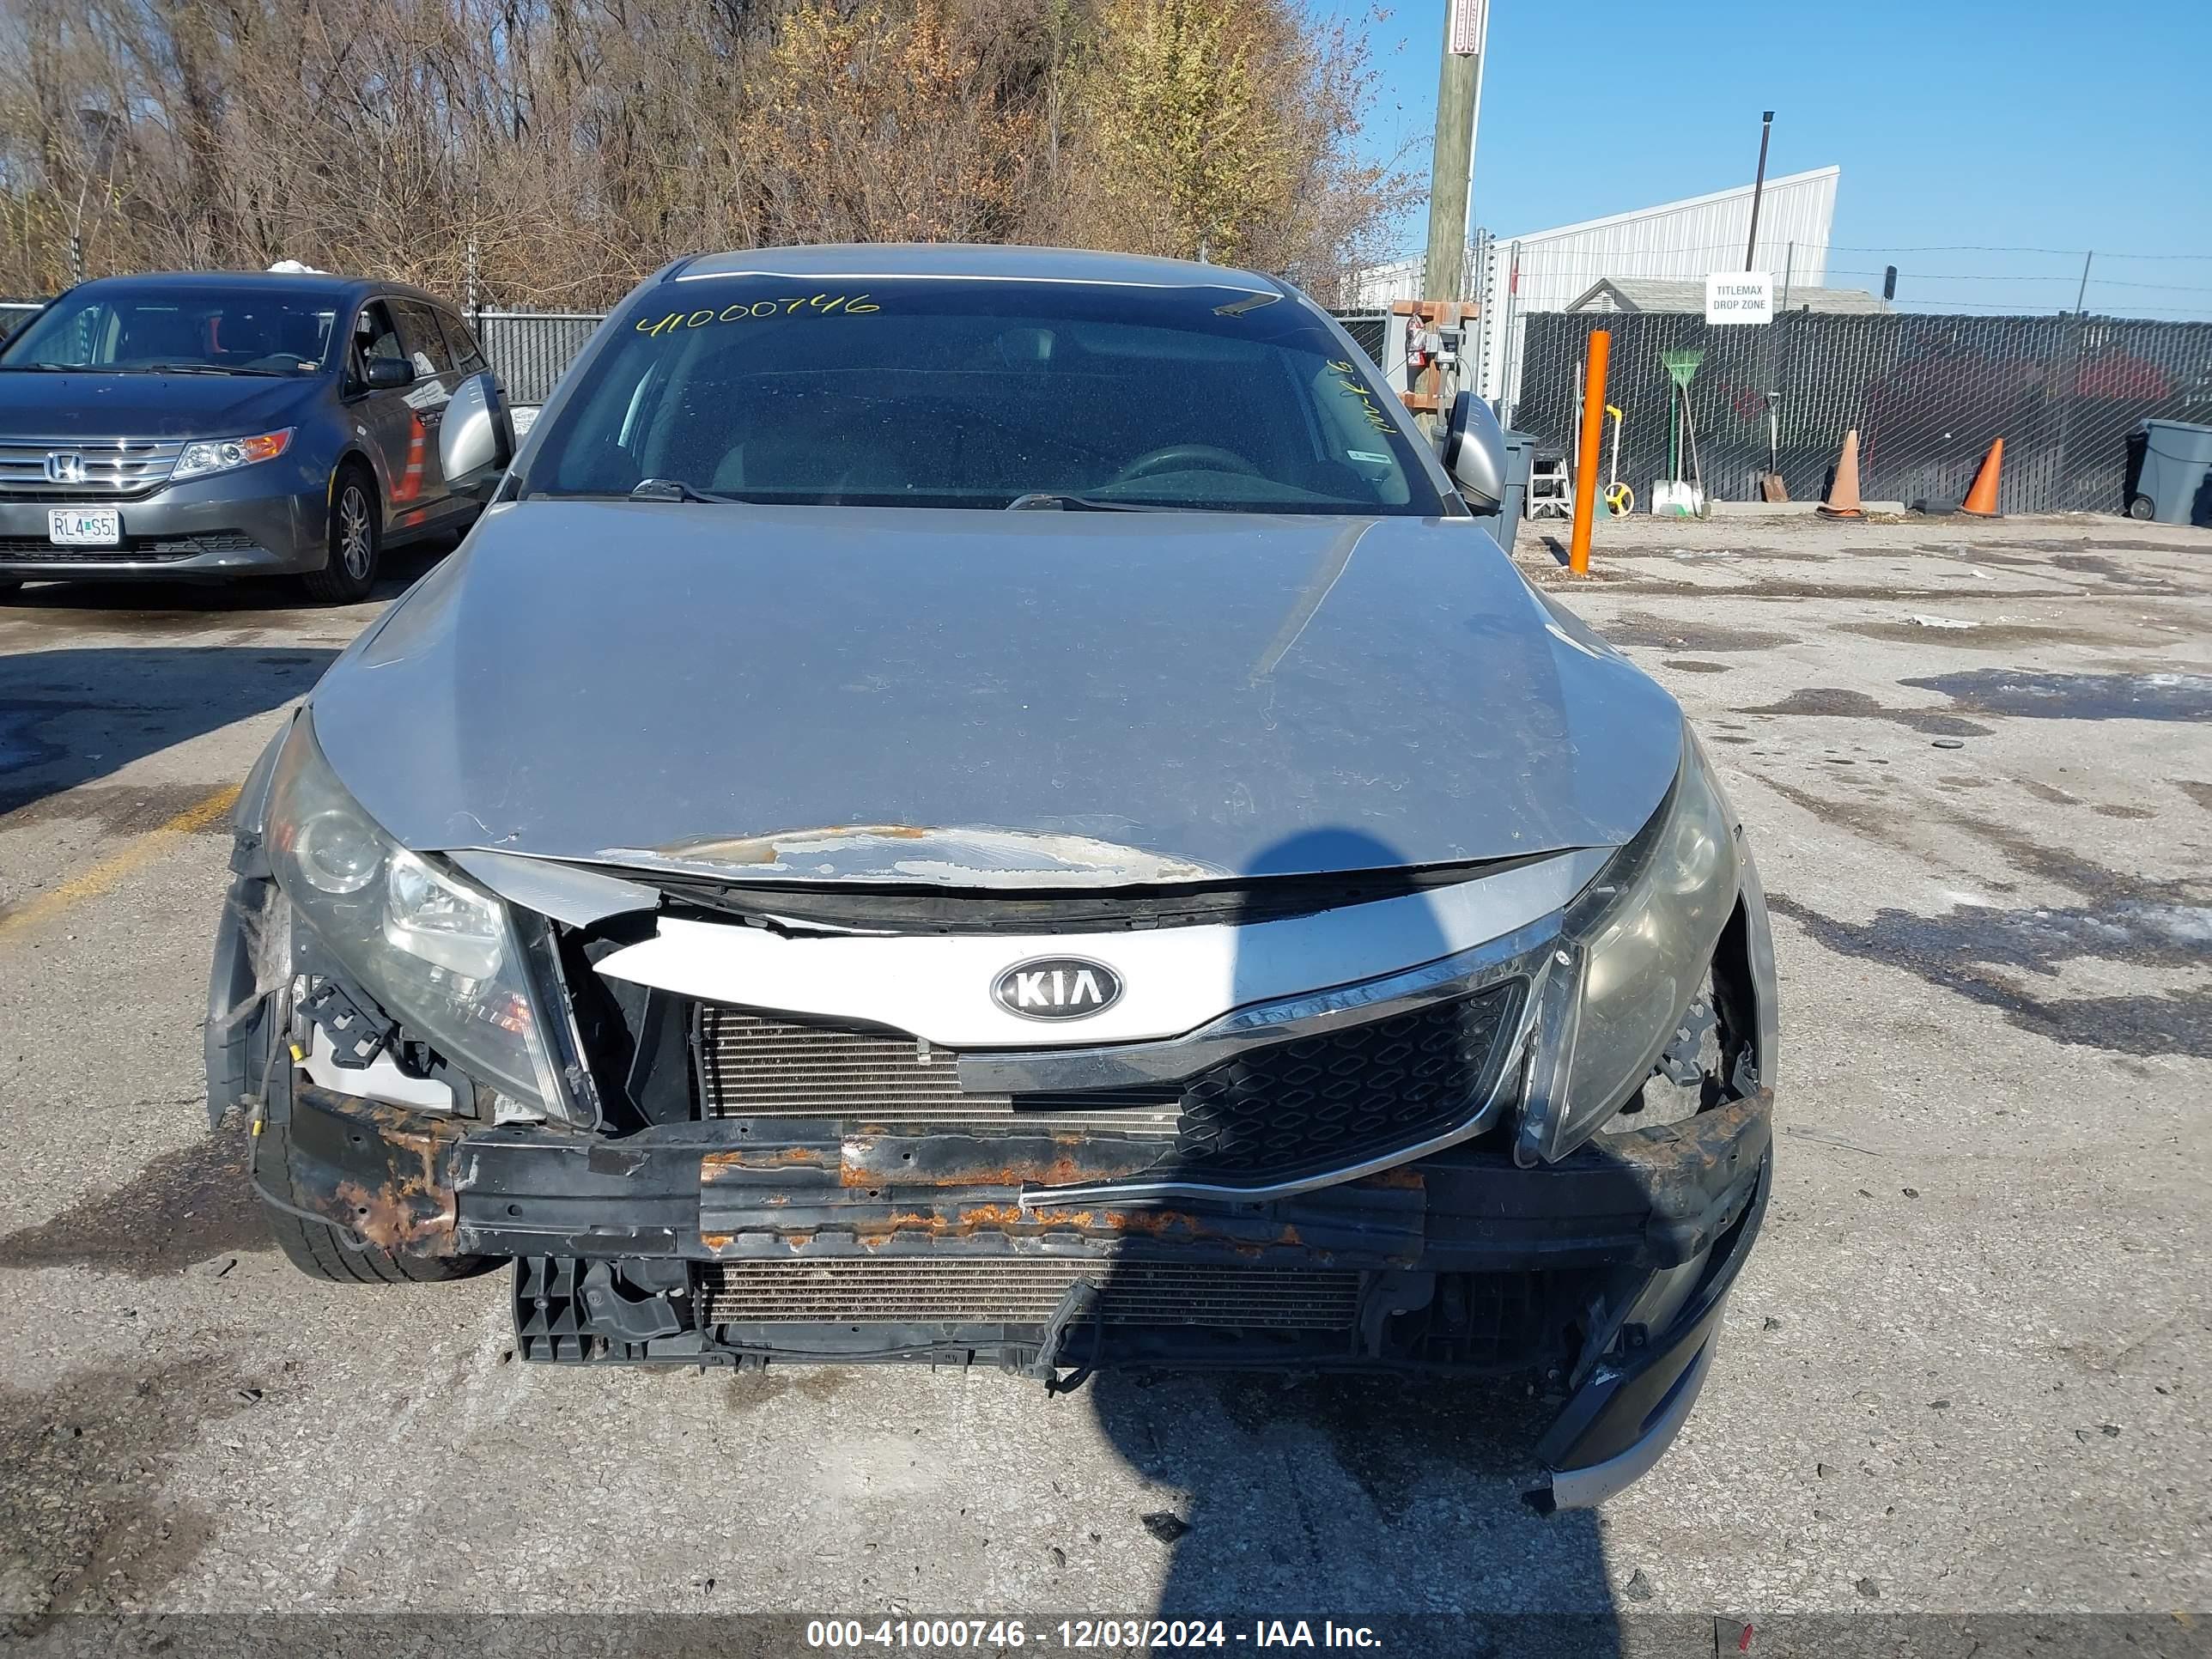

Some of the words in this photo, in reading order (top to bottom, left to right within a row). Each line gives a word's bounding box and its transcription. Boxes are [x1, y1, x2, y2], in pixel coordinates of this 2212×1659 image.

[1717, 285, 1762, 295] TITLEMAX
[635, 294, 880, 337] 41000746
[1714, 300, 1739, 309] DROP
[1741, 300, 1766, 309] ZONE
[1016, 970, 1103, 1006] KIA
